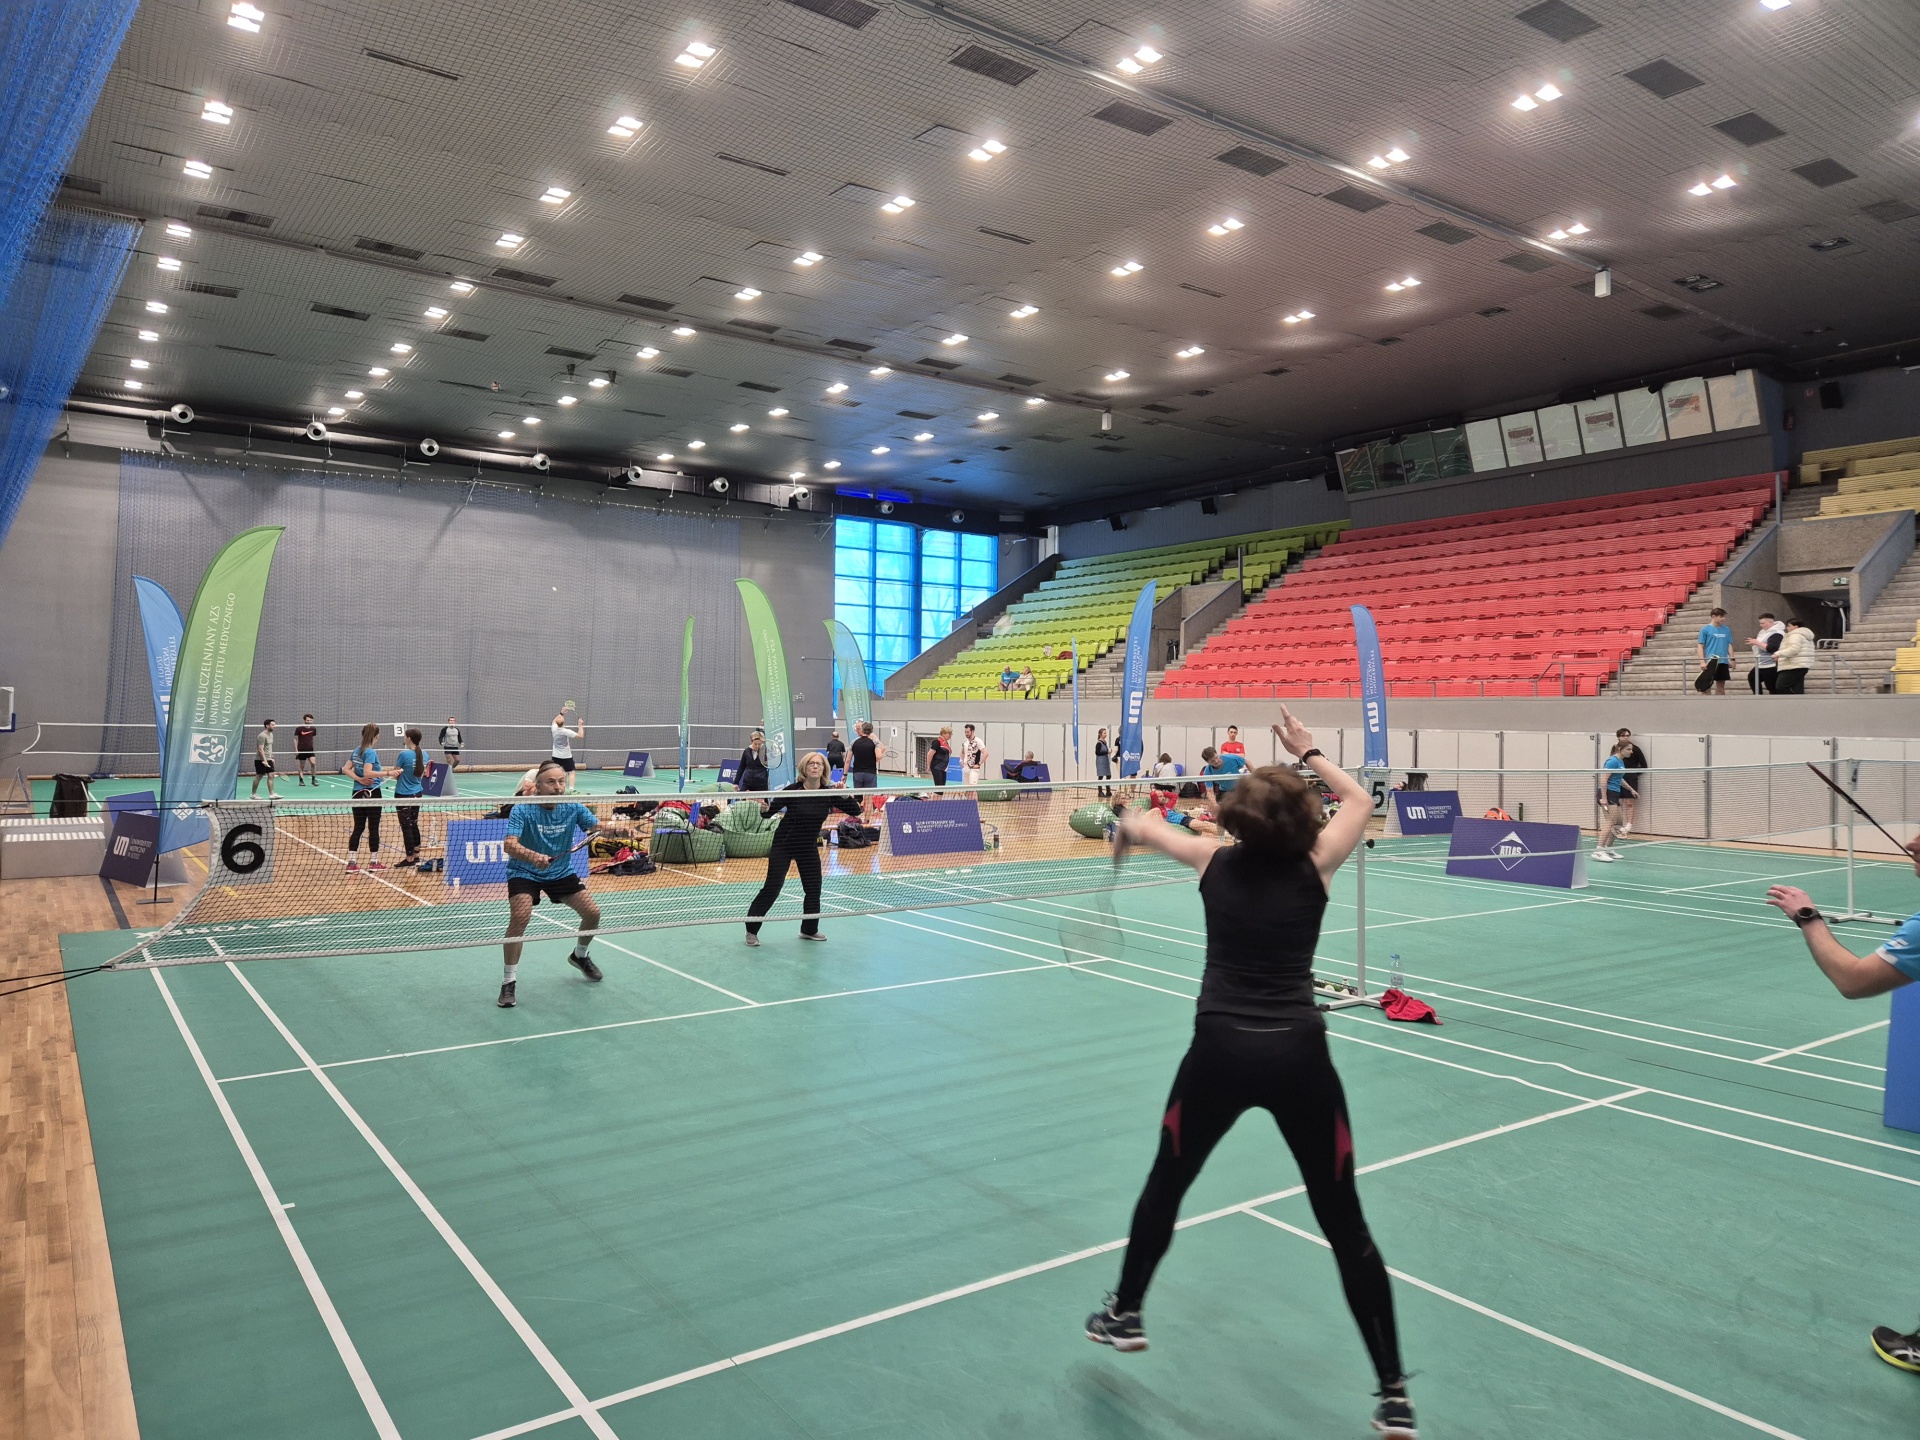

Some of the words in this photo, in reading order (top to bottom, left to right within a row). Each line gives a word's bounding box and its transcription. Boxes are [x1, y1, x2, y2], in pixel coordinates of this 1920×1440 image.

[209, 605, 221, 625] AZS
[198, 625, 218, 694] UCZELNIANY
[209, 656, 226, 725] UNIWERSYTETU
[220, 592, 236, 655] MEDYCZNEGO
[194, 696, 205, 723] KLUB
[396, 727, 403, 735] 3
[1371, 781, 1386, 809] 5
[221, 824, 266, 874] 6
[1500, 845, 1522, 856] ATLAS
